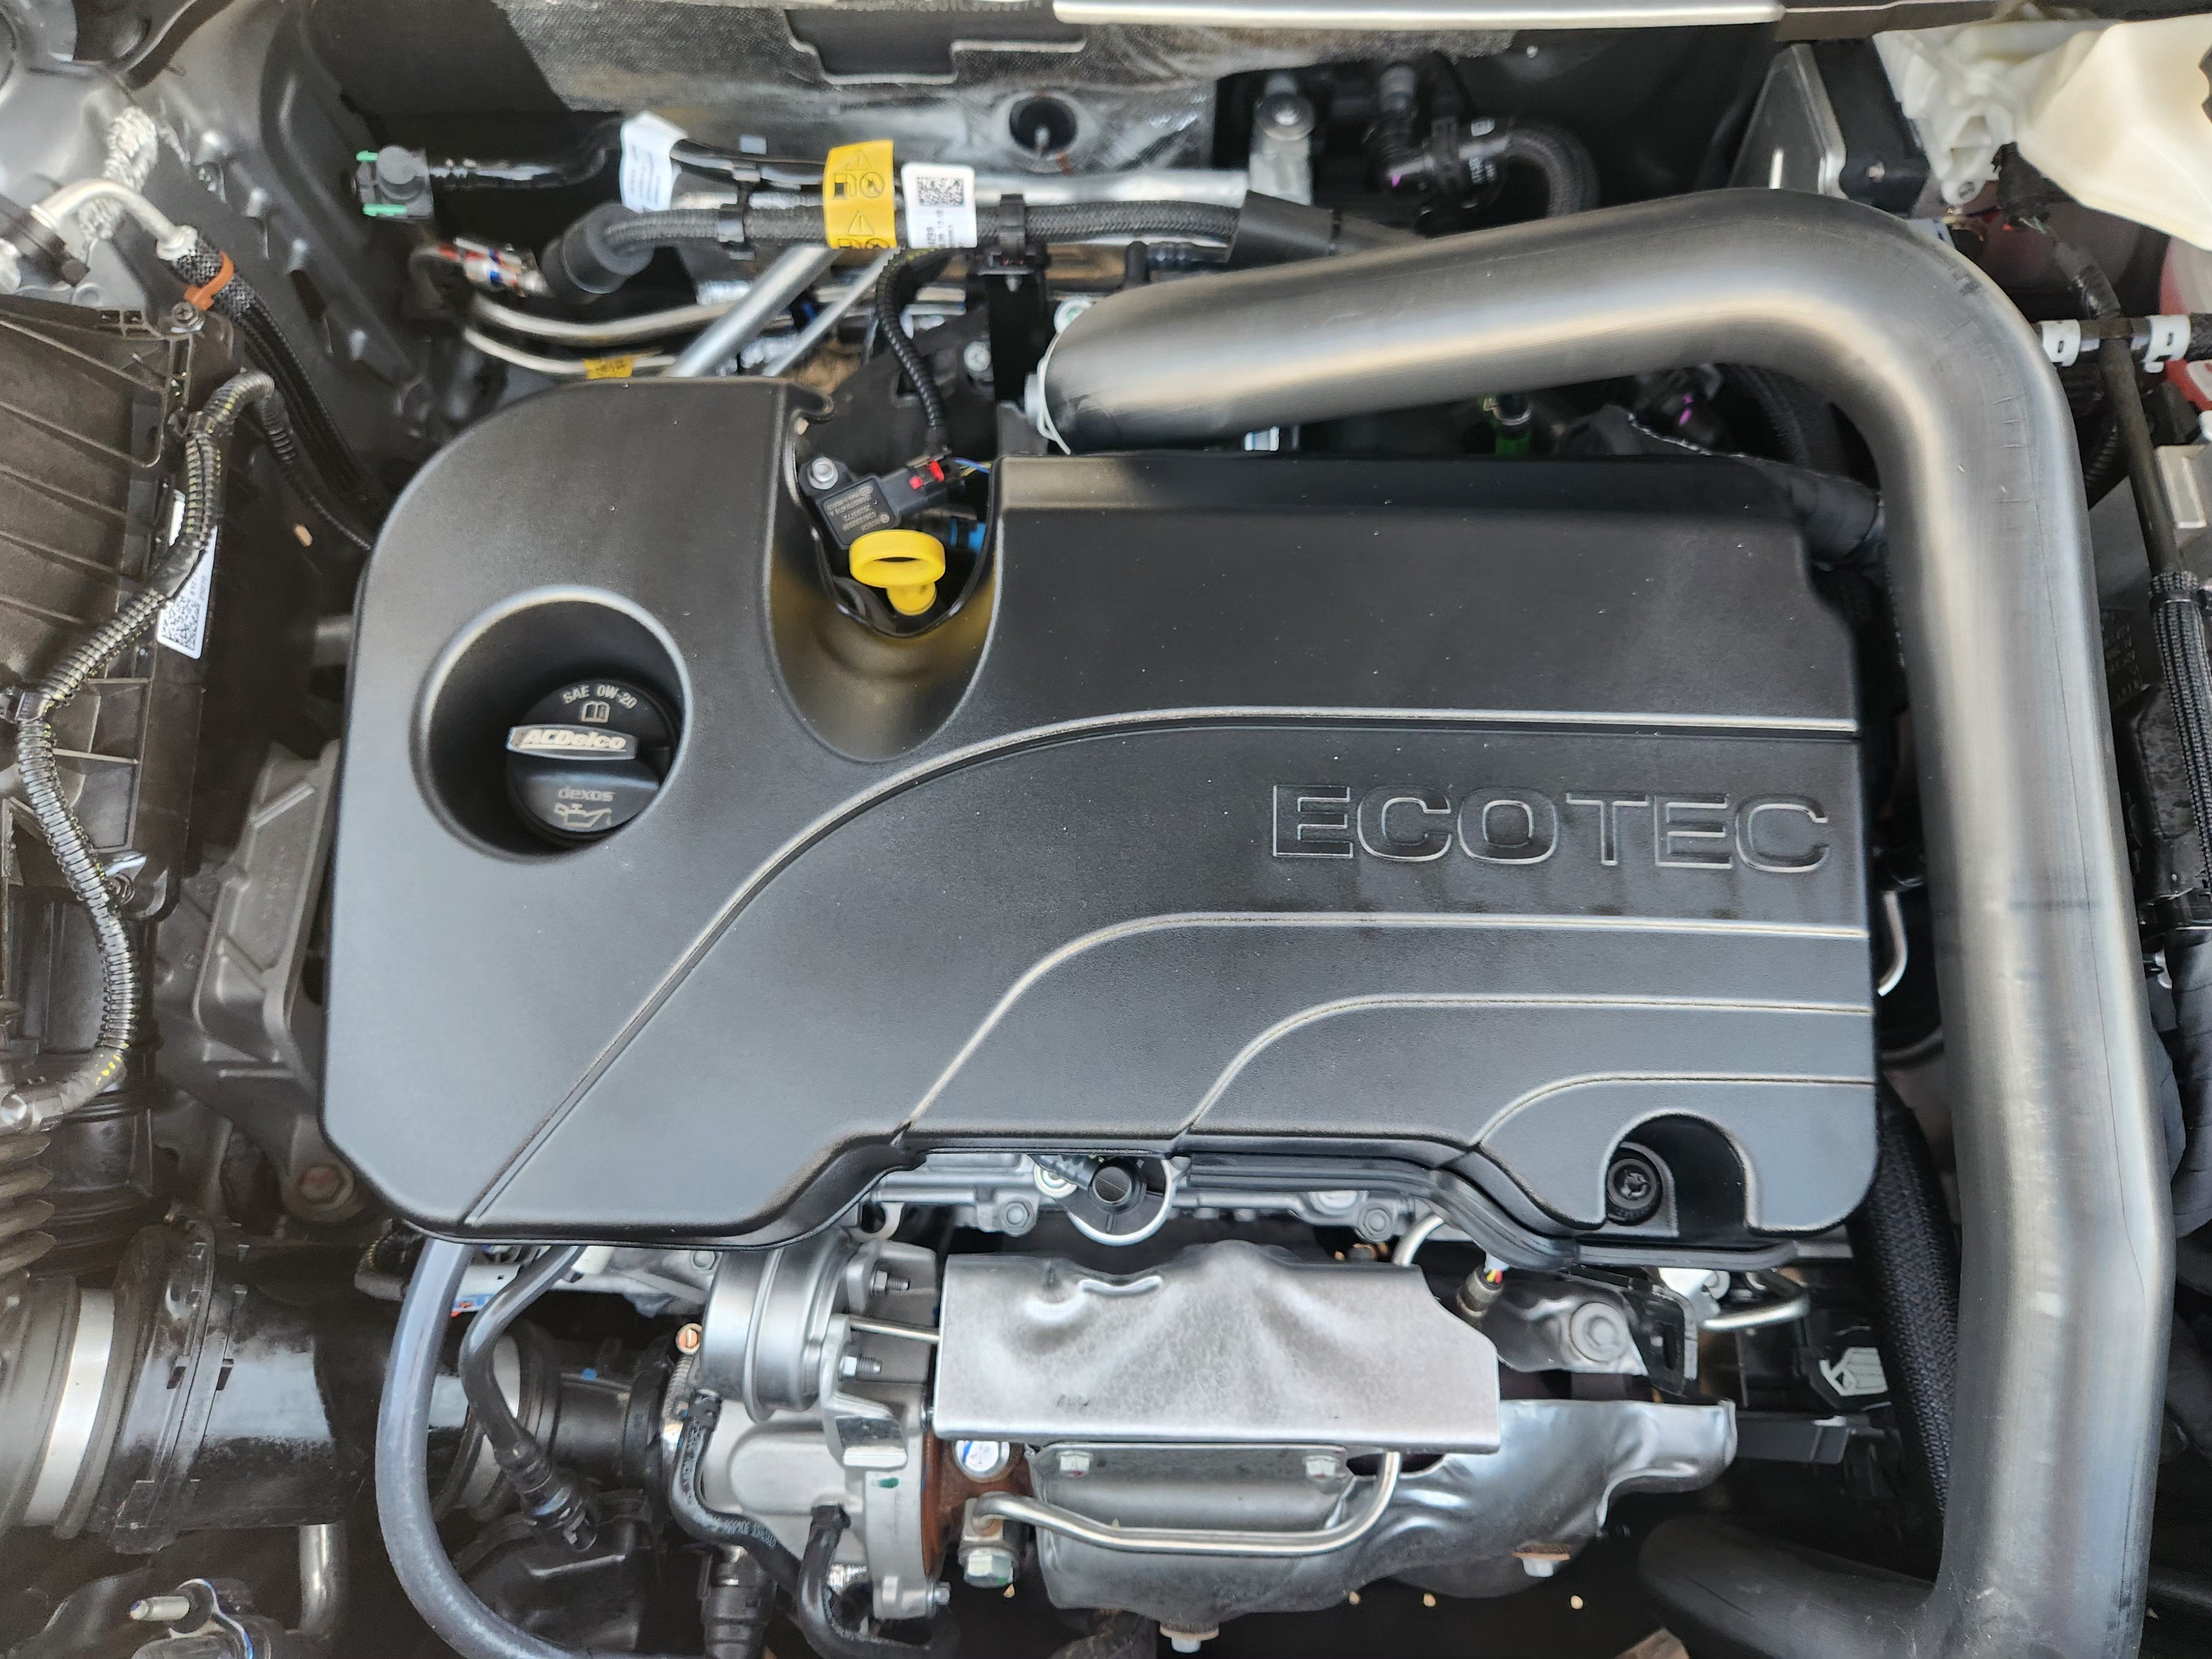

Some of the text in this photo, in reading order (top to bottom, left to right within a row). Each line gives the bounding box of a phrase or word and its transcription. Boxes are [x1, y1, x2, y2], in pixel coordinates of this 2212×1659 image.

[562, 684, 638, 709] SAE 0W-20
[521, 728, 627, 751] ACDelco
[558, 787, 615, 802] dexos
[1272, 784, 1829, 873] ECOTEC
